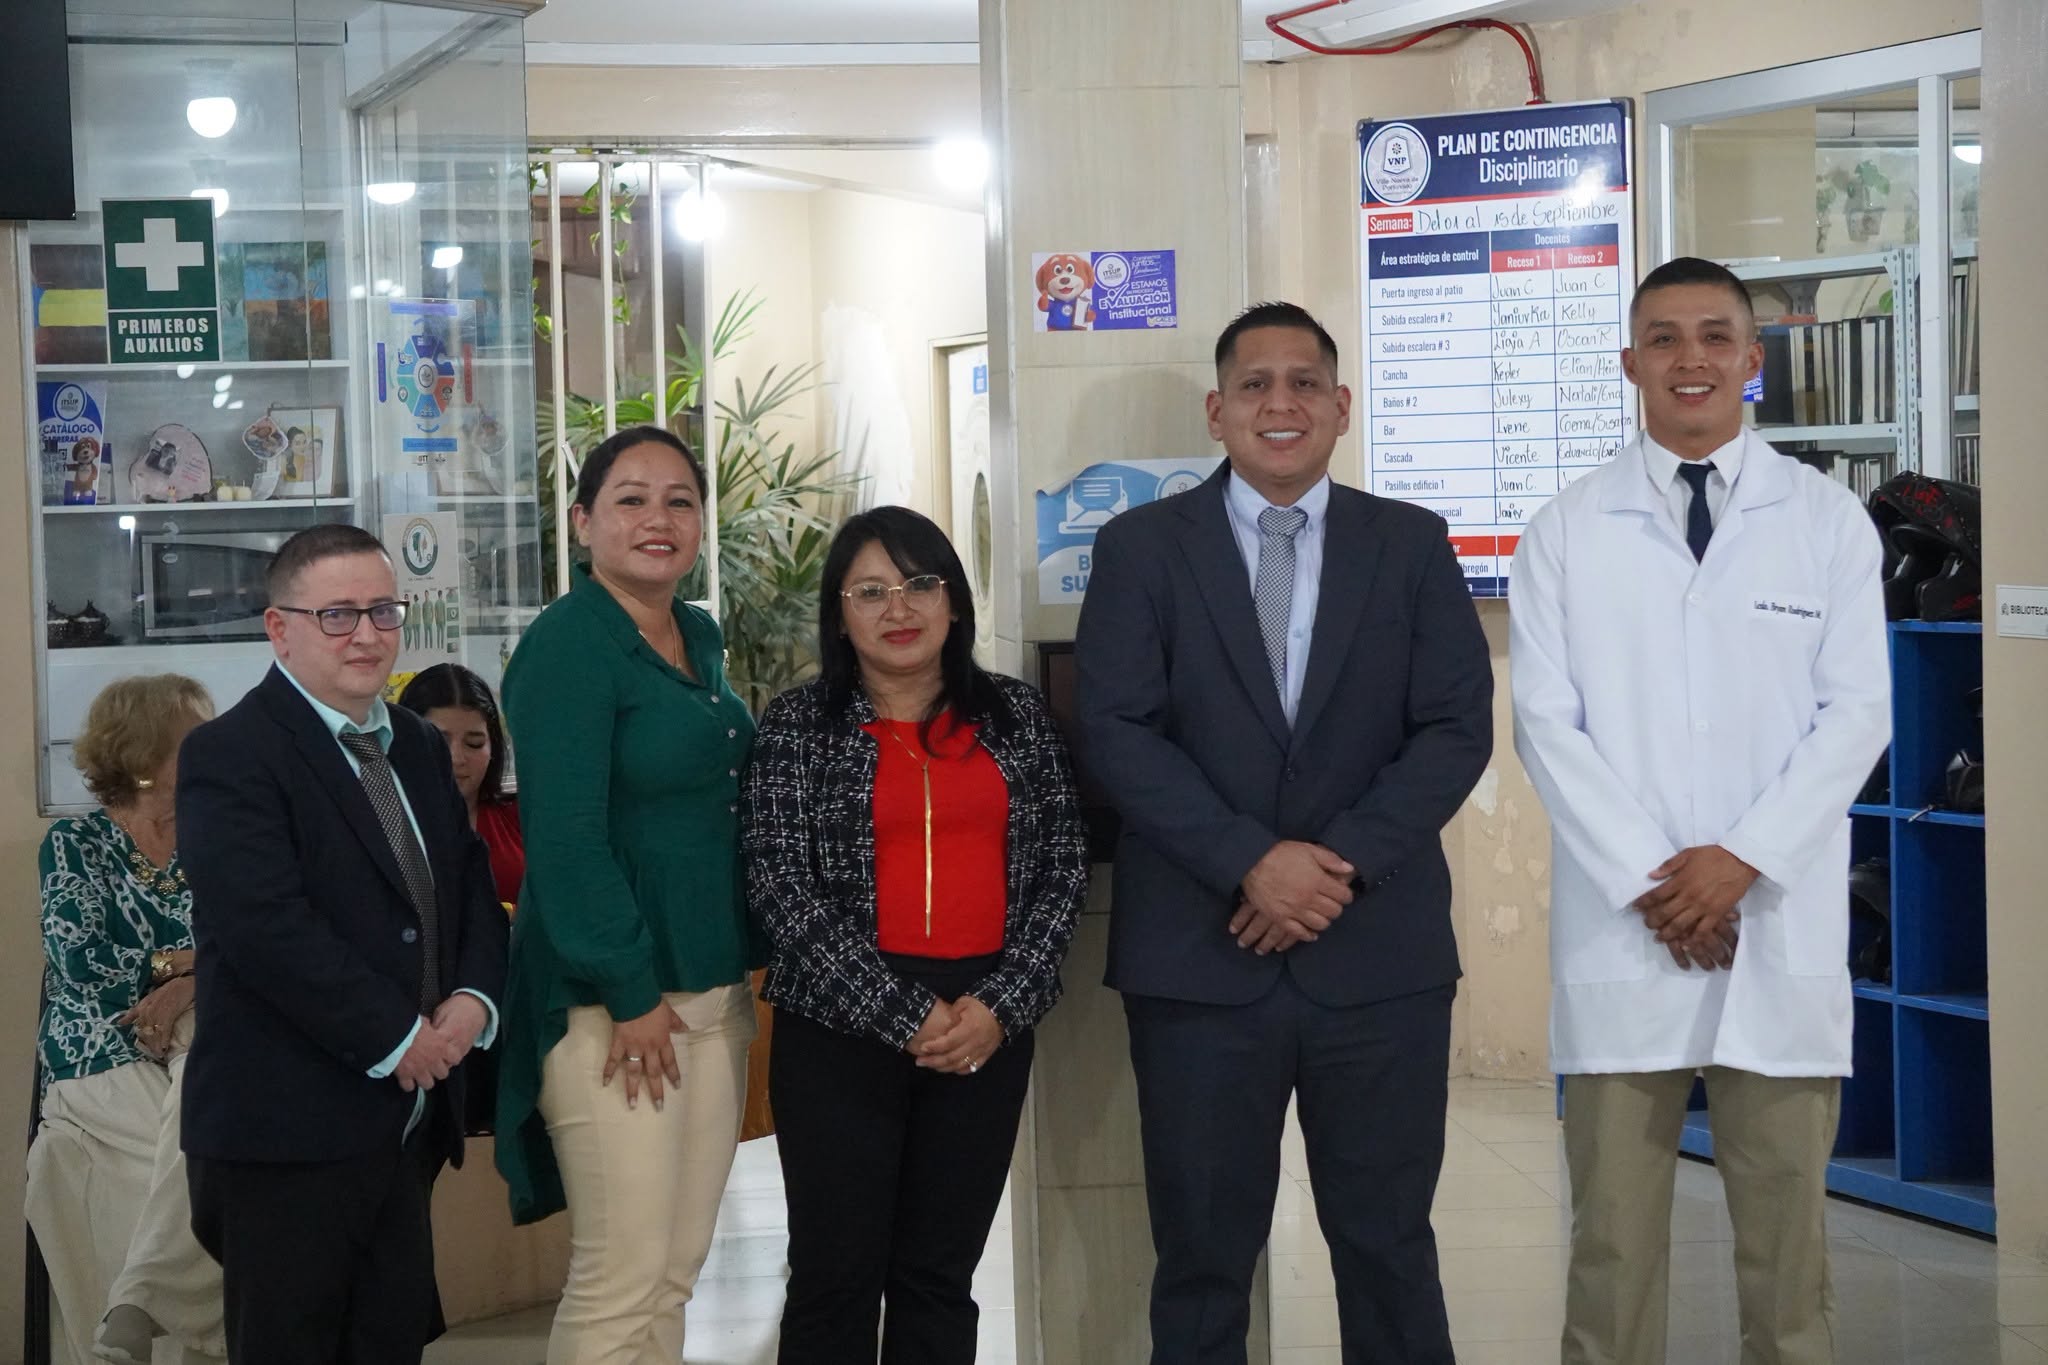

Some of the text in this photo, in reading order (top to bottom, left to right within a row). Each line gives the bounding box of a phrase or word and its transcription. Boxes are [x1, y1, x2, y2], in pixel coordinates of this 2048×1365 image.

[1438, 122, 1617, 157] PLAN DE CONTINGENCIA
[1388, 157, 1407, 165] VNP
[1479, 154, 1578, 186] Disciplinario
[1465, 205, 1481, 229] al
[1511, 204, 1528, 226] de
[1532, 198, 1619, 228] Septiembre
[1370, 216, 1412, 232] Semana:
[1535, 233, 1570, 246] Docentes
[1380, 248, 1480, 266] Área estratégica de control
[1507, 255, 1541, 268] Receso 1
[1568, 251, 1604, 265] Receso 2
[1131, 278, 1168, 290] ESTAMOS
[1381, 284, 1463, 299] Puerta ingreso al patio
[1098, 290, 1170, 310] EVALUACIÓN
[1108, 303, 1172, 320] institucional
[1561, 302, 1596, 321] Kelly
[118, 317, 209, 335] PRIMEROS
[1382, 312, 1453, 326] Subida escalera # 2
[124, 336, 204, 354] AUXILIOS
[1382, 340, 1450, 354] Subida escalera # 3
[1382, 369, 1408, 380] Cancha
[1383, 396, 1418, 408] Baños # 2
[42, 422, 95, 434] CATÁLOGO
[1384, 425, 1396, 436] Bar
[1384, 452, 1413, 464] Cascada
[1384, 480, 1445, 492] Pasillos edificio 1
[1461, 562, 1488, 576] bregón
